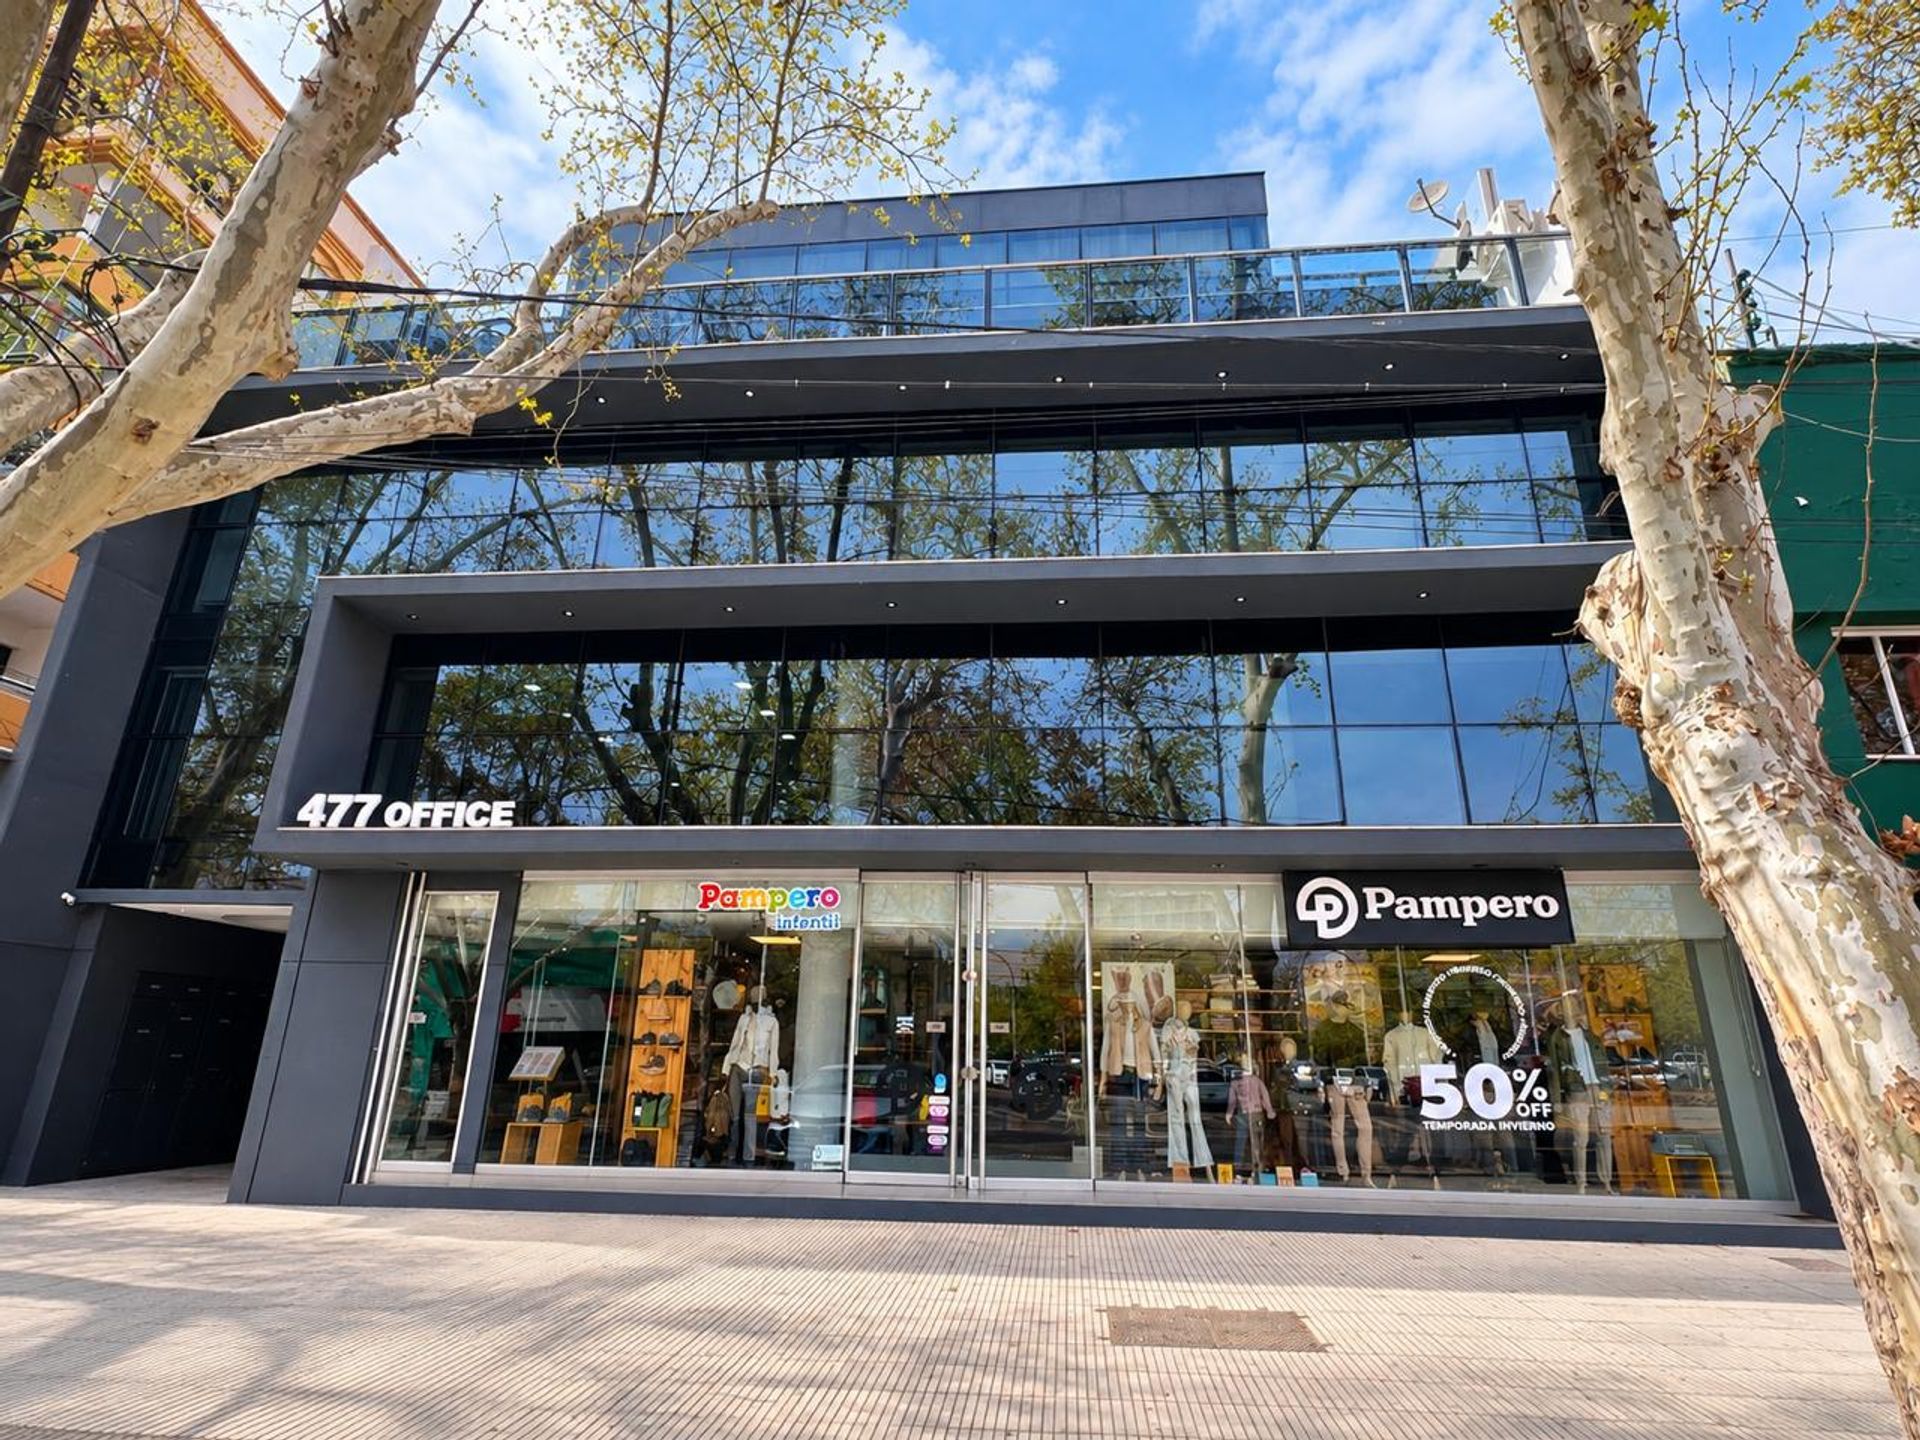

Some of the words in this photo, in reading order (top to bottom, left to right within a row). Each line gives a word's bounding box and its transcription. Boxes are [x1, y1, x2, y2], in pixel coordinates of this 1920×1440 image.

[297, 793, 382, 827] 477
[384, 801, 516, 827] OFFICE
[698, 882, 840, 913] Pampero
[1362, 887, 1559, 927] Pampero
[1422, 1120, 1497, 1131] TEMPORADA
[1499, 1120, 1556, 1131] INVIERNO
[1516, 1103, 1553, 1118] OFF
